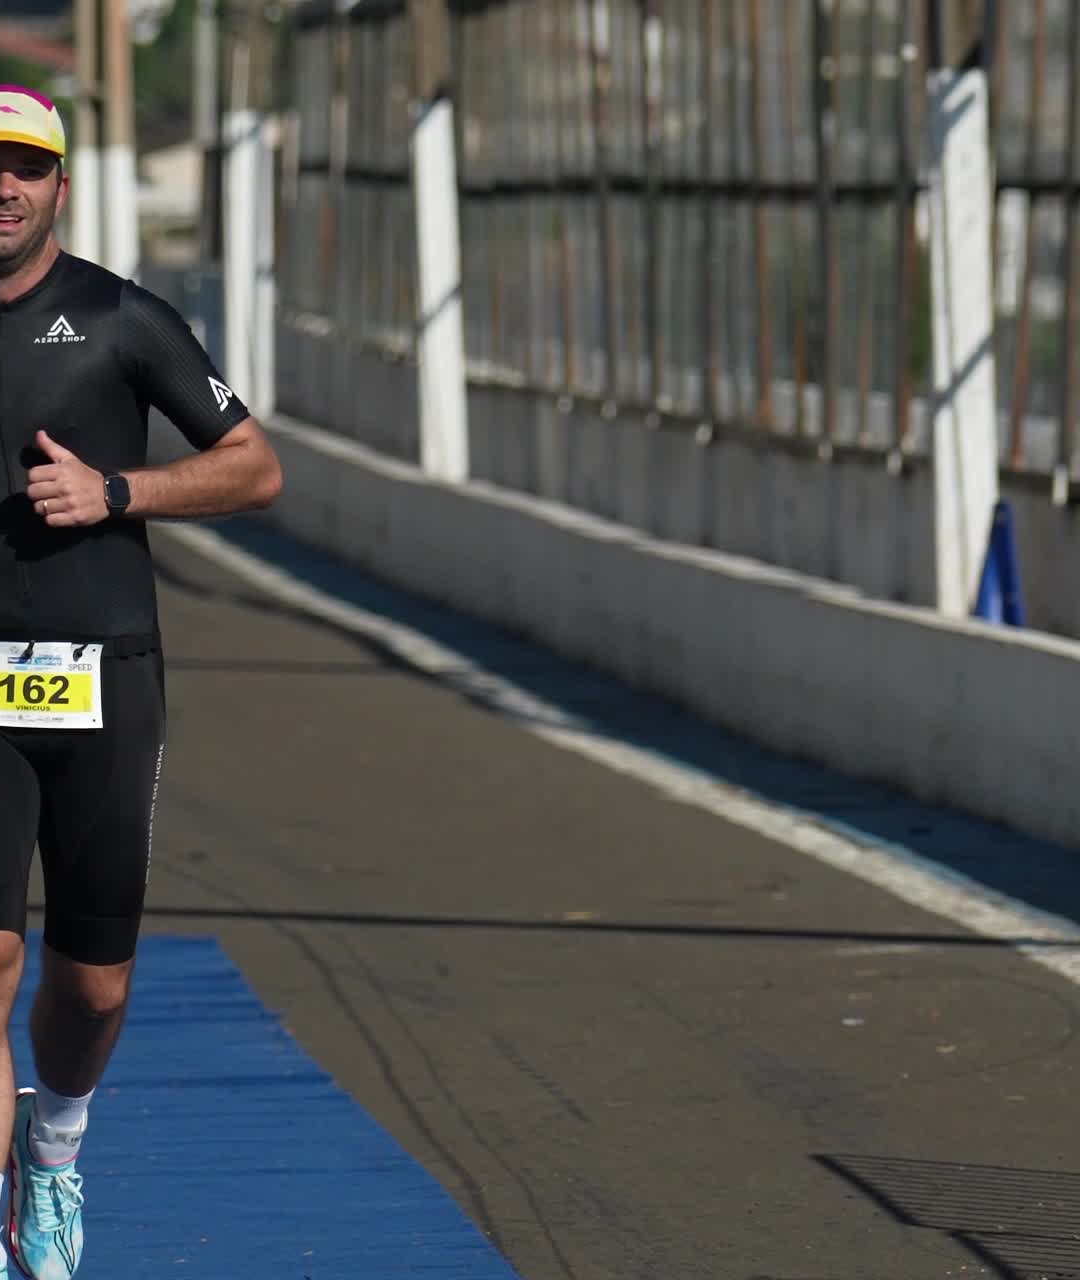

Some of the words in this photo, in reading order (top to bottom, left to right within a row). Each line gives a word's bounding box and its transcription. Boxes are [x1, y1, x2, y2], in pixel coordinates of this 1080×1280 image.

[62, 335, 86, 343] SHOP
[68, 663, 93, 672] SPEED
[0, 674, 69, 704] 162
[16, 704, 51, 712] VINICIUS
